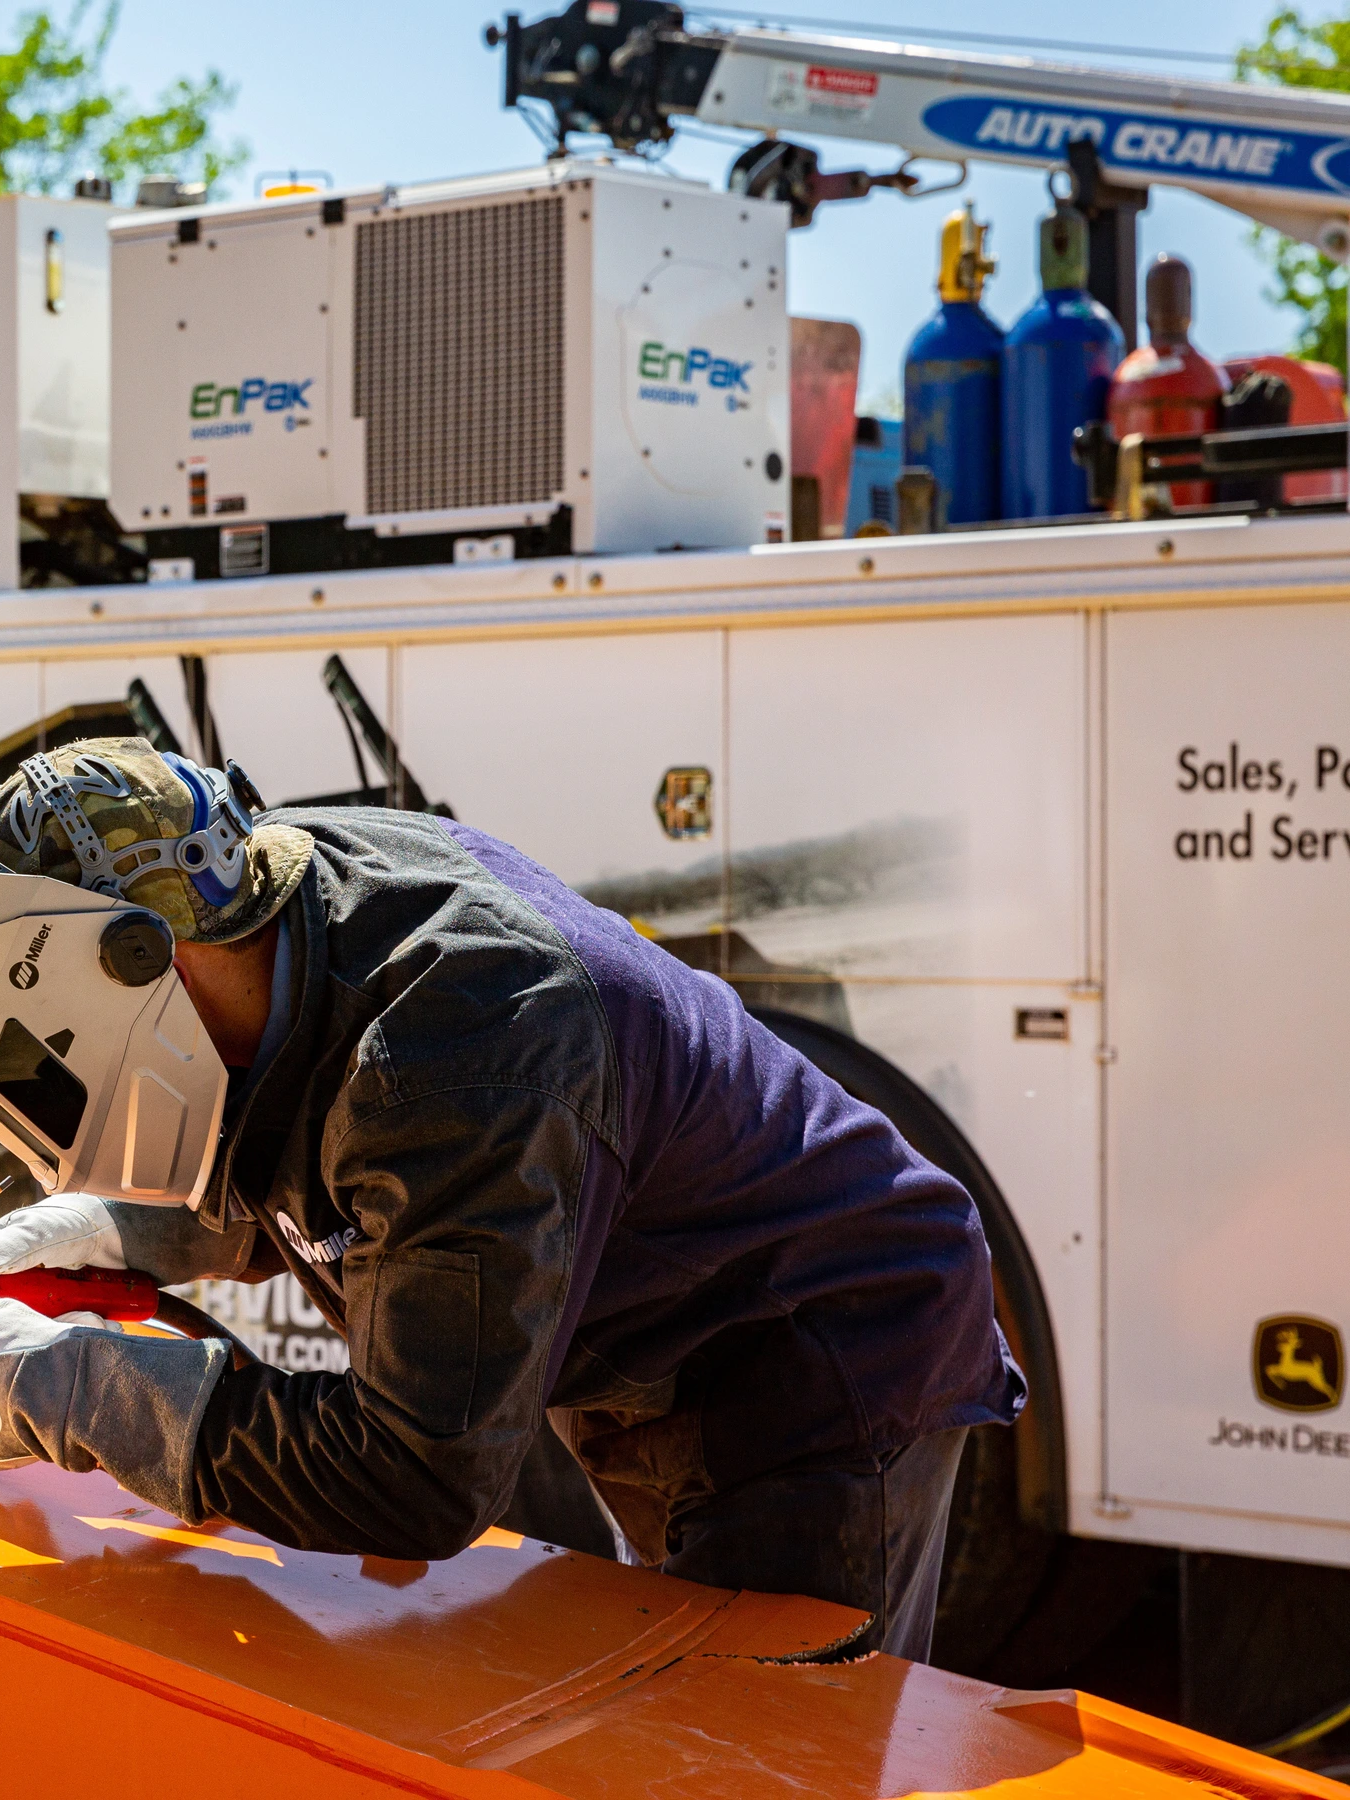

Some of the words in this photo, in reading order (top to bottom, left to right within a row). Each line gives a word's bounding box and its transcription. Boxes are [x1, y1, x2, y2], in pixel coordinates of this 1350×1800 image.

[977, 106, 1107, 151] AUTO
[1111, 121, 1283, 177] CRANE
[639, 341, 754, 394] EnPak
[190, 376, 314, 419] EnPak
[1176, 742, 1298, 801] Sales,
[1174, 811, 1253, 860] and
[25, 923, 52, 962] Miller
[305, 1227, 359, 1263] Mille
[1208, 1416, 1289, 1451] JOHN
